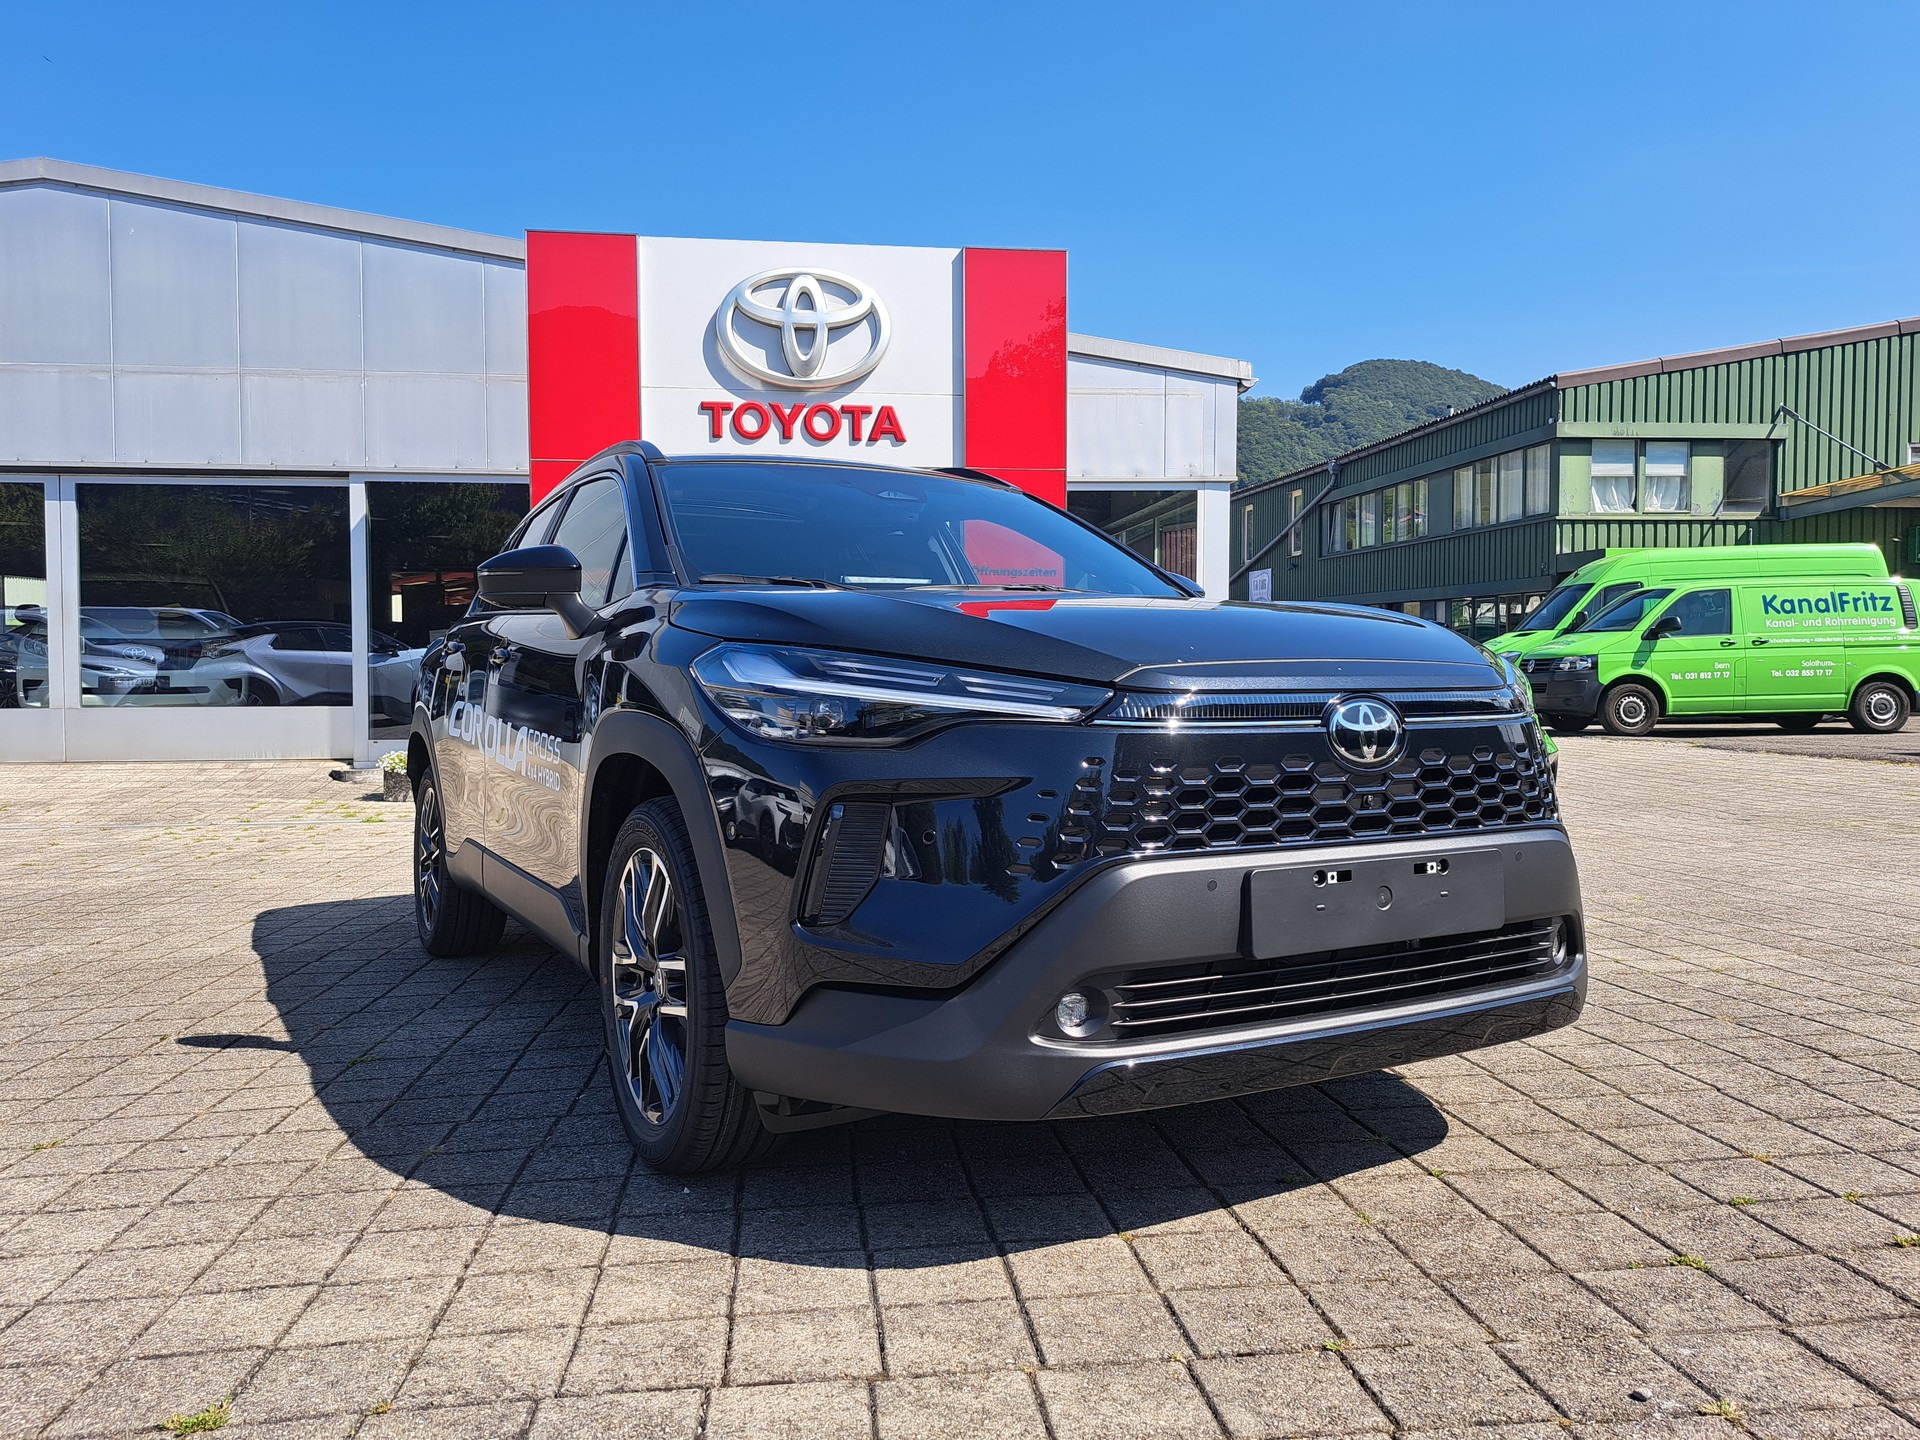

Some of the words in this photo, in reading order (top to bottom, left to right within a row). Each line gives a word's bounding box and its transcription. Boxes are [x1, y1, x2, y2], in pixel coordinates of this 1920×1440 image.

[700, 401, 907, 442] TOYOTA
[1762, 591, 1893, 615] KanalFritz
[1766, 618, 1799, 628] Kanal-
[1802, 617, 1822, 627] und
[1825, 616, 1897, 627] Rohrreinigung
[1685, 672, 1698, 680] 031
[1723, 671, 1730, 679] 17
[1714, 661, 1730, 669] Bern
[1785, 669, 1799, 677] 032
[448, 701, 529, 777] COROLLA
[527, 729, 562, 765] CROSS
[537, 768, 561, 792] HYBRID
